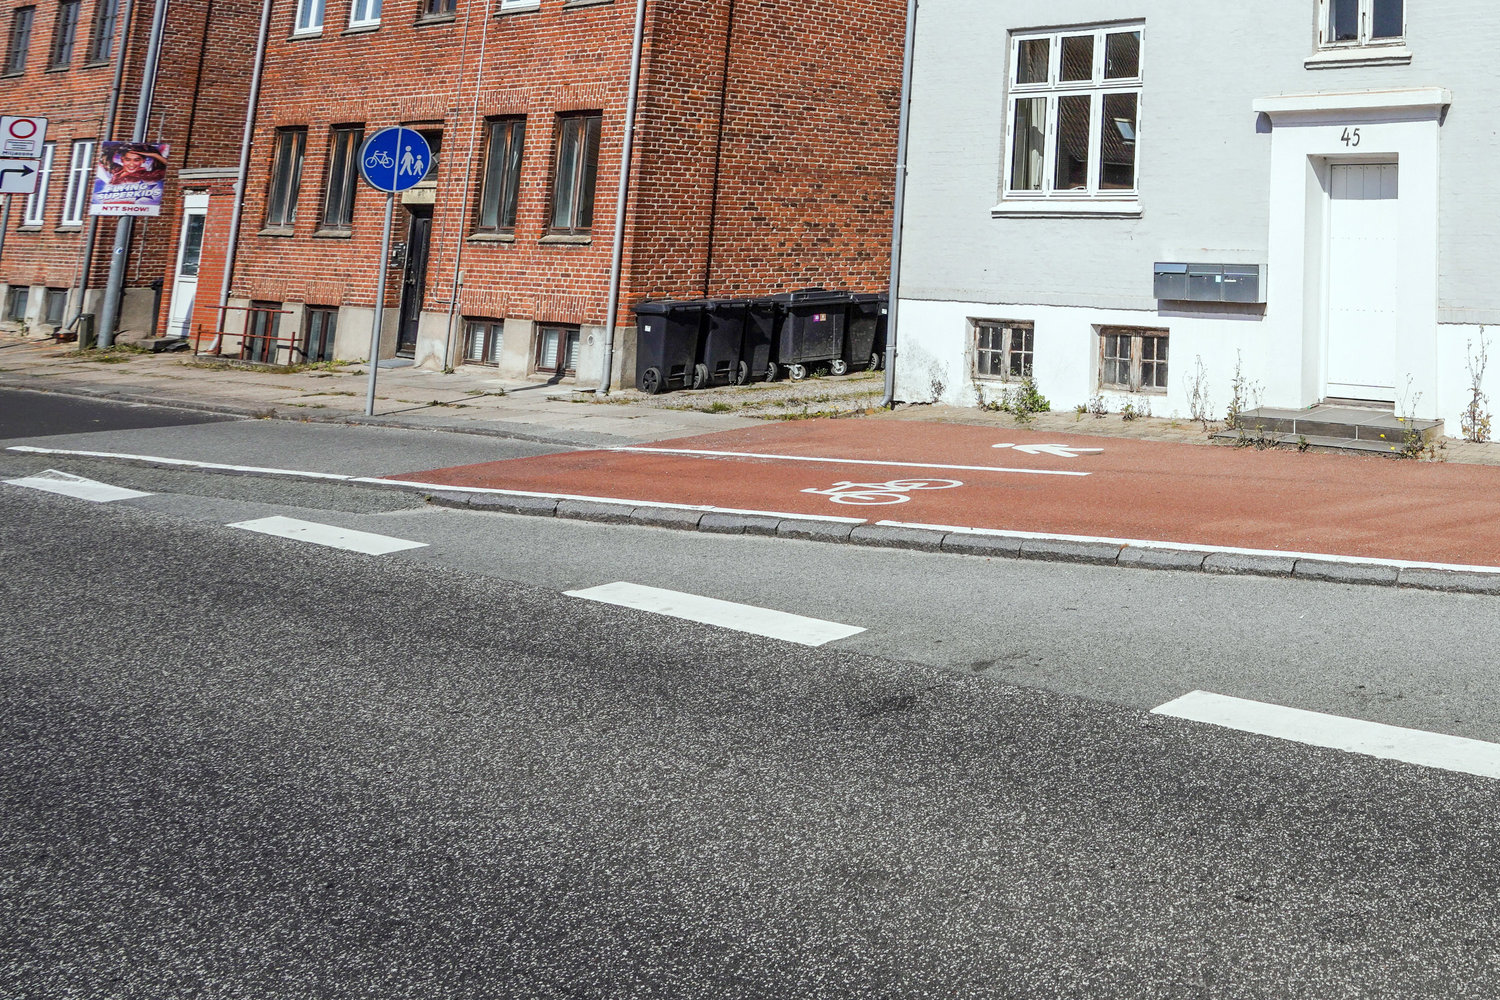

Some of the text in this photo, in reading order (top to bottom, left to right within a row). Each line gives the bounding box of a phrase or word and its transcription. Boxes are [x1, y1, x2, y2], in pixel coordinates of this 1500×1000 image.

[1341, 127, 1360, 147] 45
[105, 183, 148, 192] FLYING
[97, 188, 161, 200] SUPERKIDS
